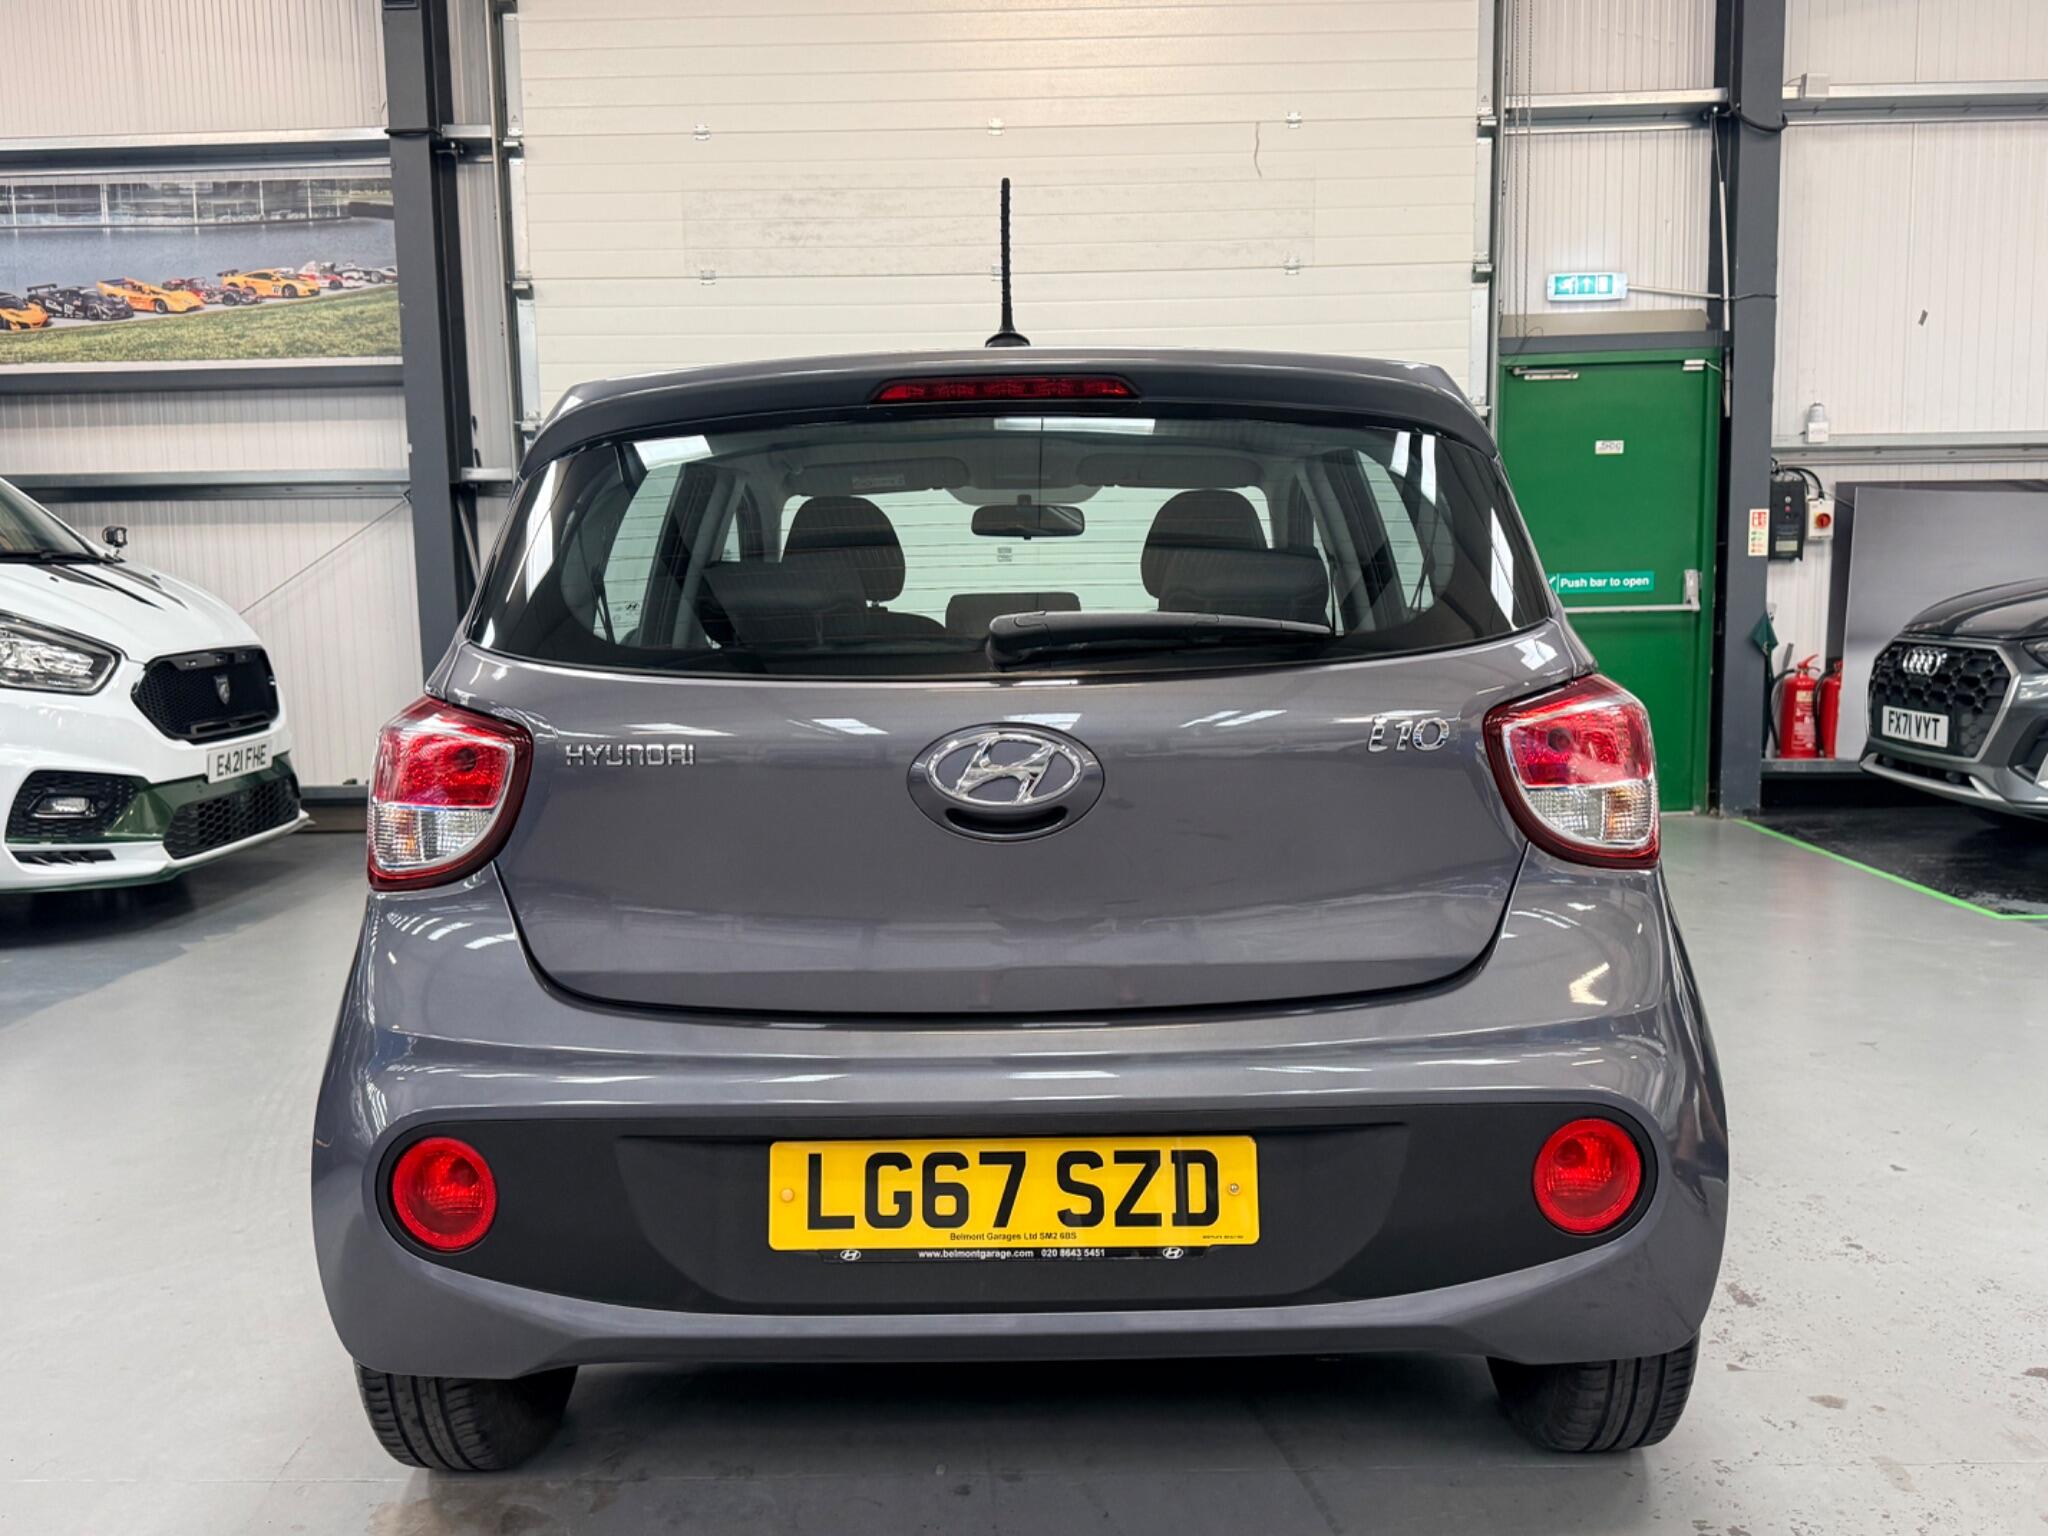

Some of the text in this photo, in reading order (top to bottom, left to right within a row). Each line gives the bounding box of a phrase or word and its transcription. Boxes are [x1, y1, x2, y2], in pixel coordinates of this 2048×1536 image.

[1560, 577, 1650, 588] Push bar to open
[1888, 709, 1940, 741] FX71 VYT
[216, 743, 267, 777] EA21 FHE
[565, 744, 695, 766] HYUNDAI
[807, 1149, 1220, 1231] LG67 SZD
[950, 1232, 985, 1241] Belmont
[986, 1232, 1022, 1242] Garages
[1023, 1232, 1038, 1241] Ltd
[1039, 1231, 1058, 1240] SM2
[918, 1249, 1034, 1260] www.belmontgarage.com
[1040, 1248, 1058, 1258] 020
[1083, 1248, 1105, 1257] 5451
